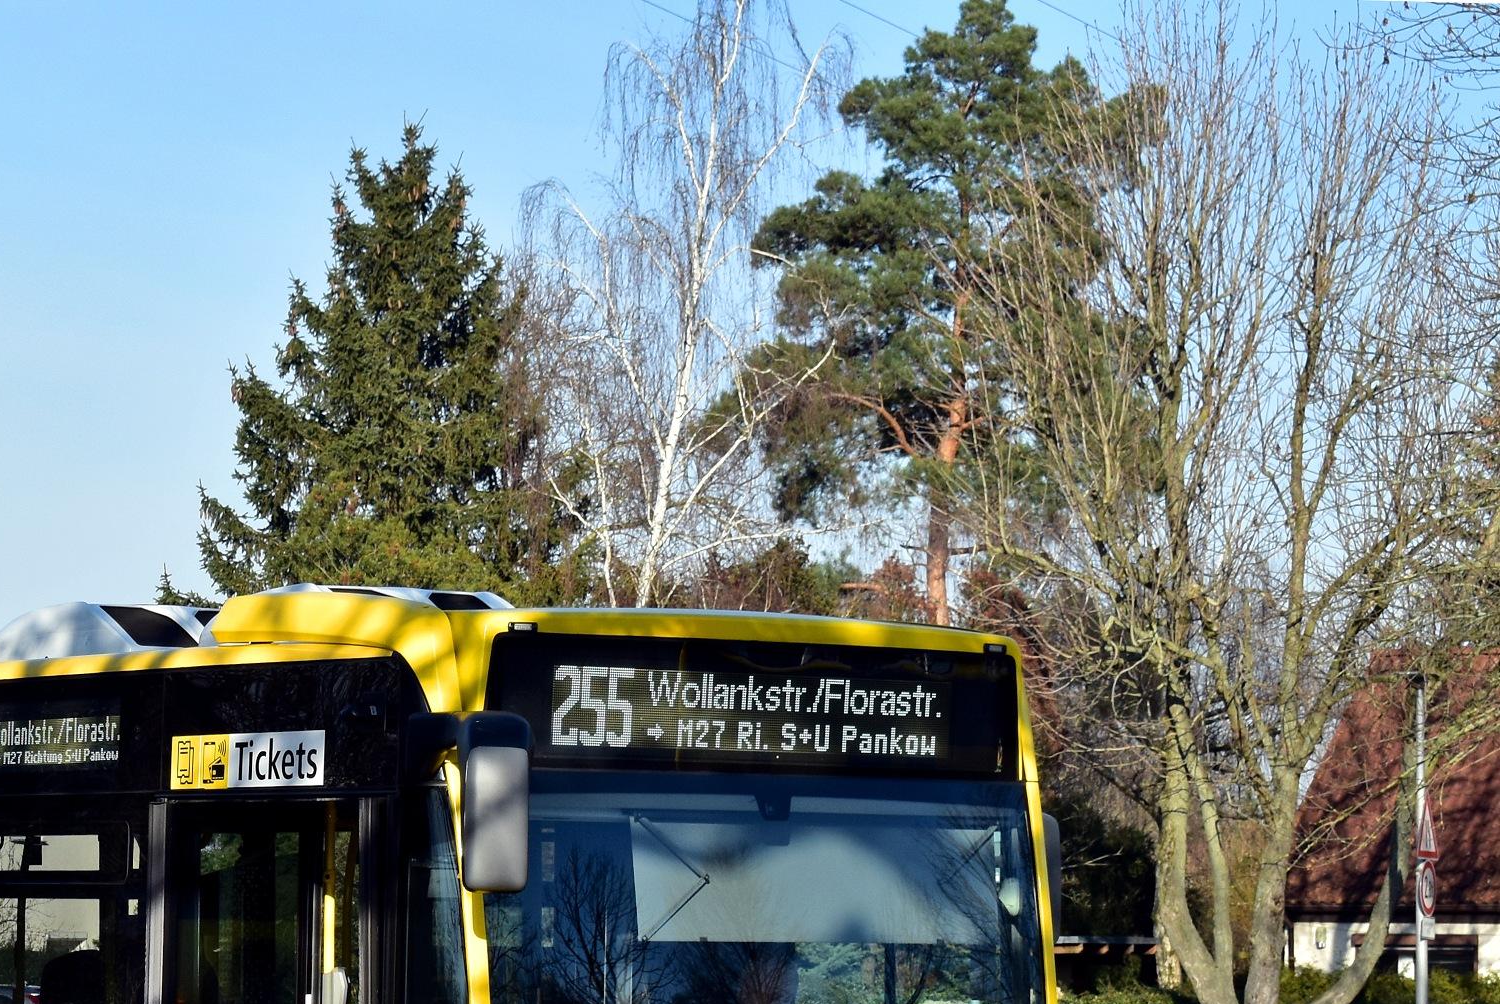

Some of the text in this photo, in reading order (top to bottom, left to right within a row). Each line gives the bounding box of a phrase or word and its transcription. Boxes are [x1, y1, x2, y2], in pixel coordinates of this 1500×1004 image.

[552, 665, 635, 748] 255
[647, 670, 942, 718] Wollankstr./Florastr.
[3, 747, 119, 765] M27 Richtung S+U Pankow
[677, 719, 936, 756] M27 Ri. S+U Pankow
[235, 738, 318, 781] Tickets
